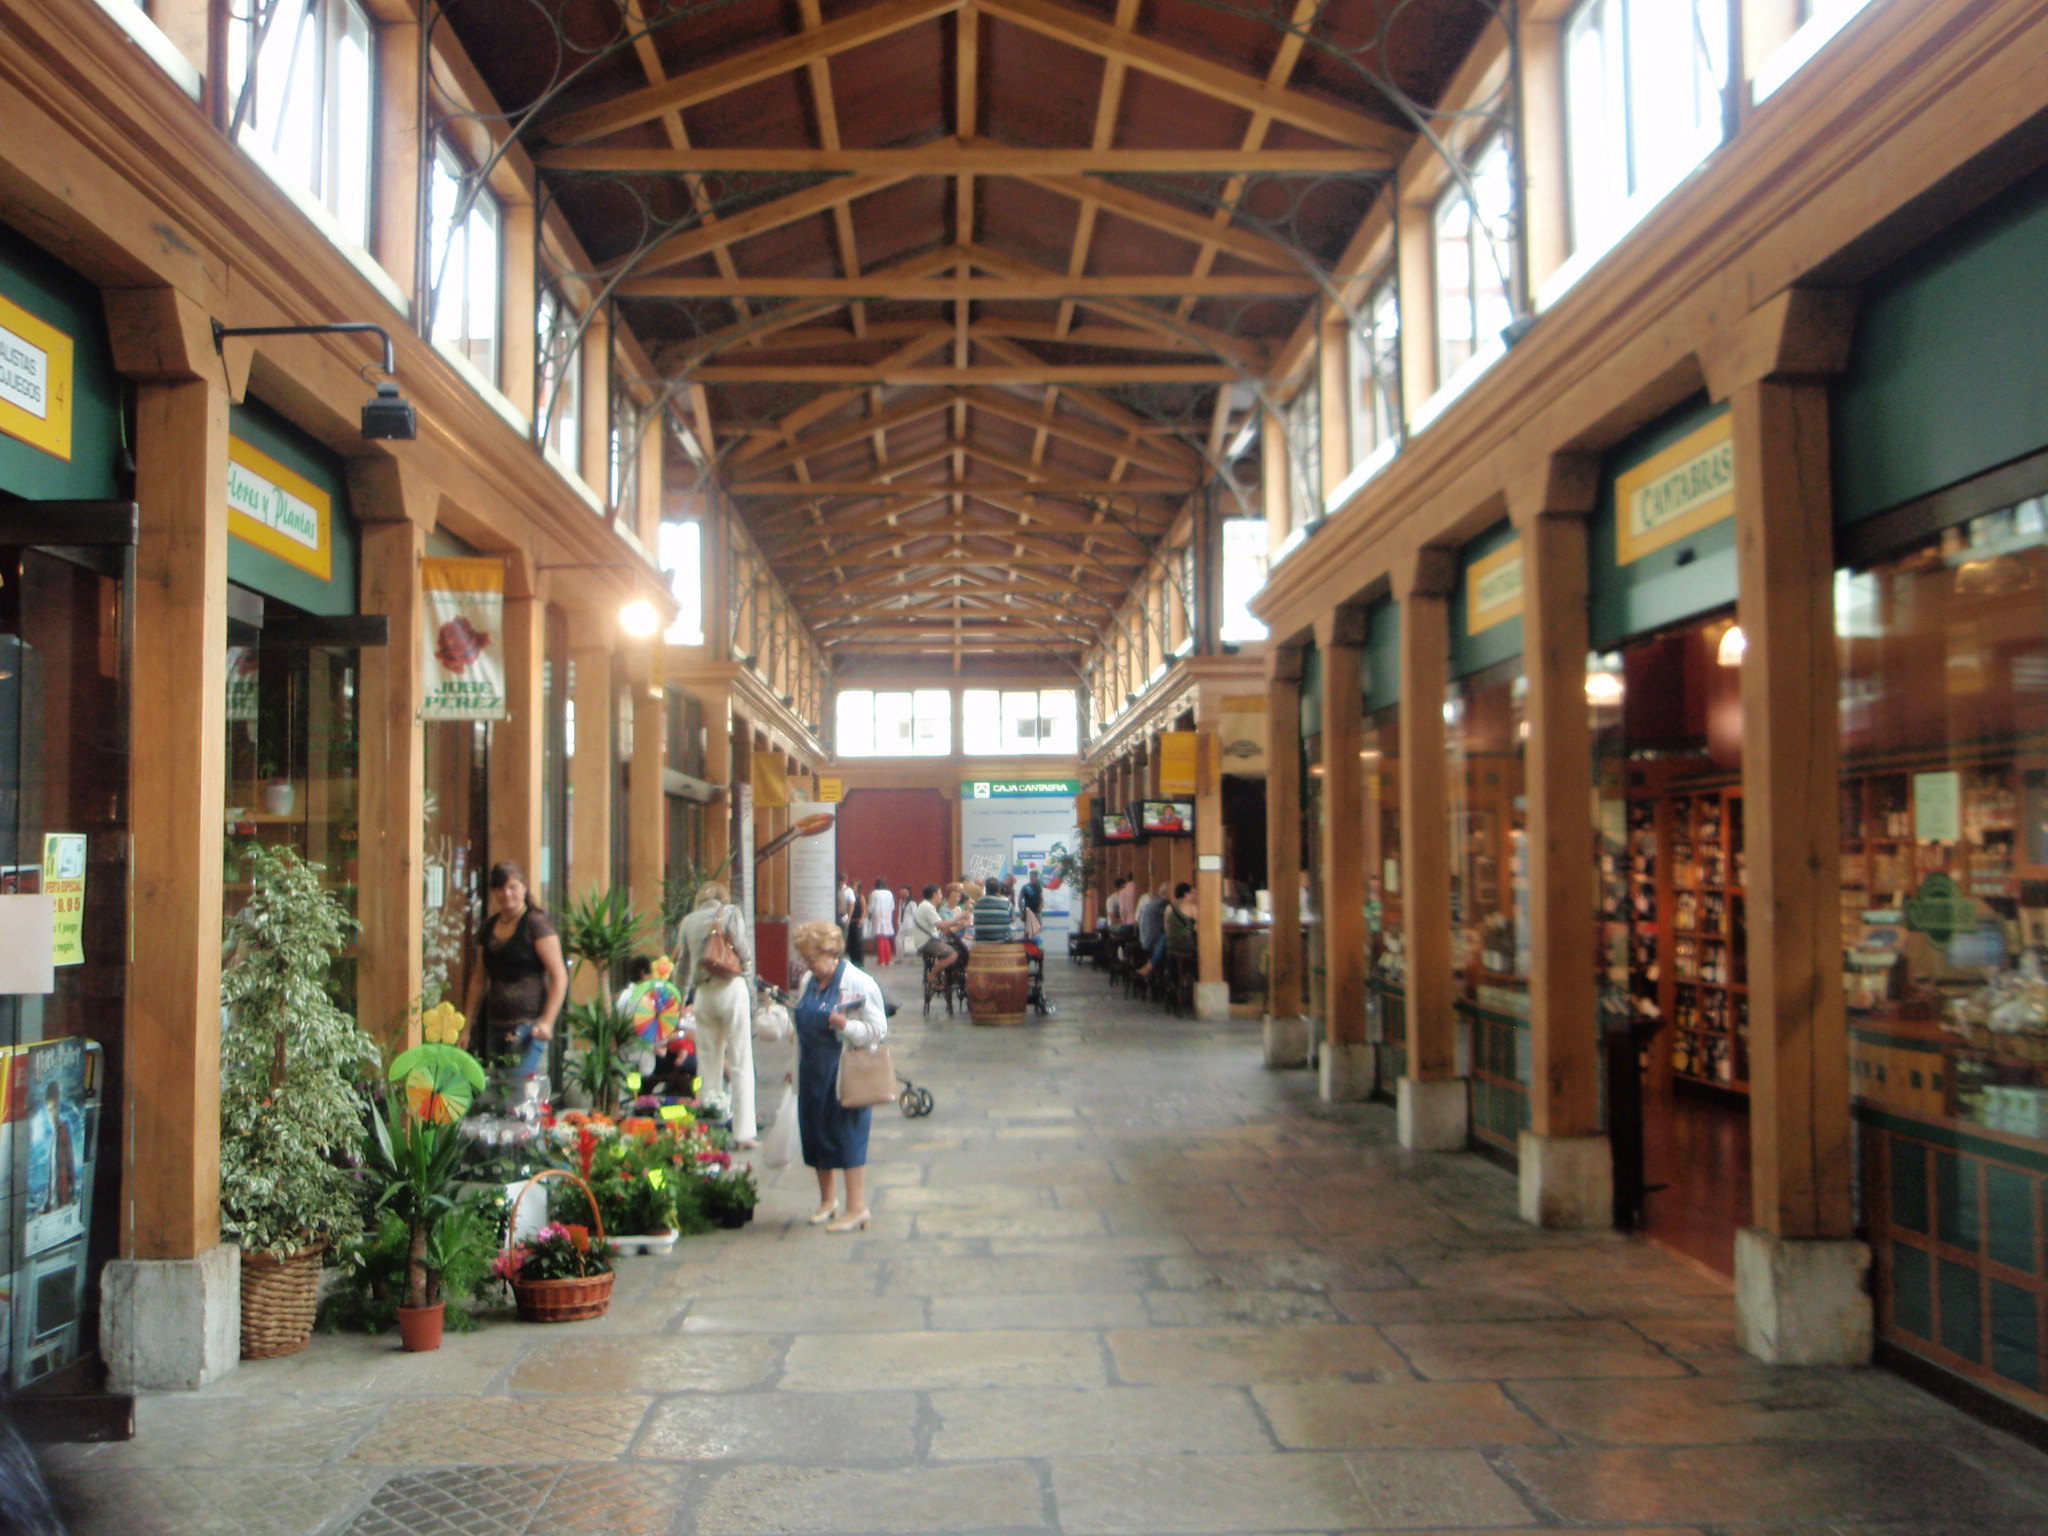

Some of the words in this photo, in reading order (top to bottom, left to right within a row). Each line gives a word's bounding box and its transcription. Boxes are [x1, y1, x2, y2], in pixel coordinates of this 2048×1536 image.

[227, 461, 260, 510] lores
[271, 486, 316, 540] Plantas
[434, 680, 493, 694] JOSE
[424, 695, 501, 709] PEREZ
[992, 783, 1018, 793] CAJA
[1018, 783, 1068, 792] CANTABRIA
